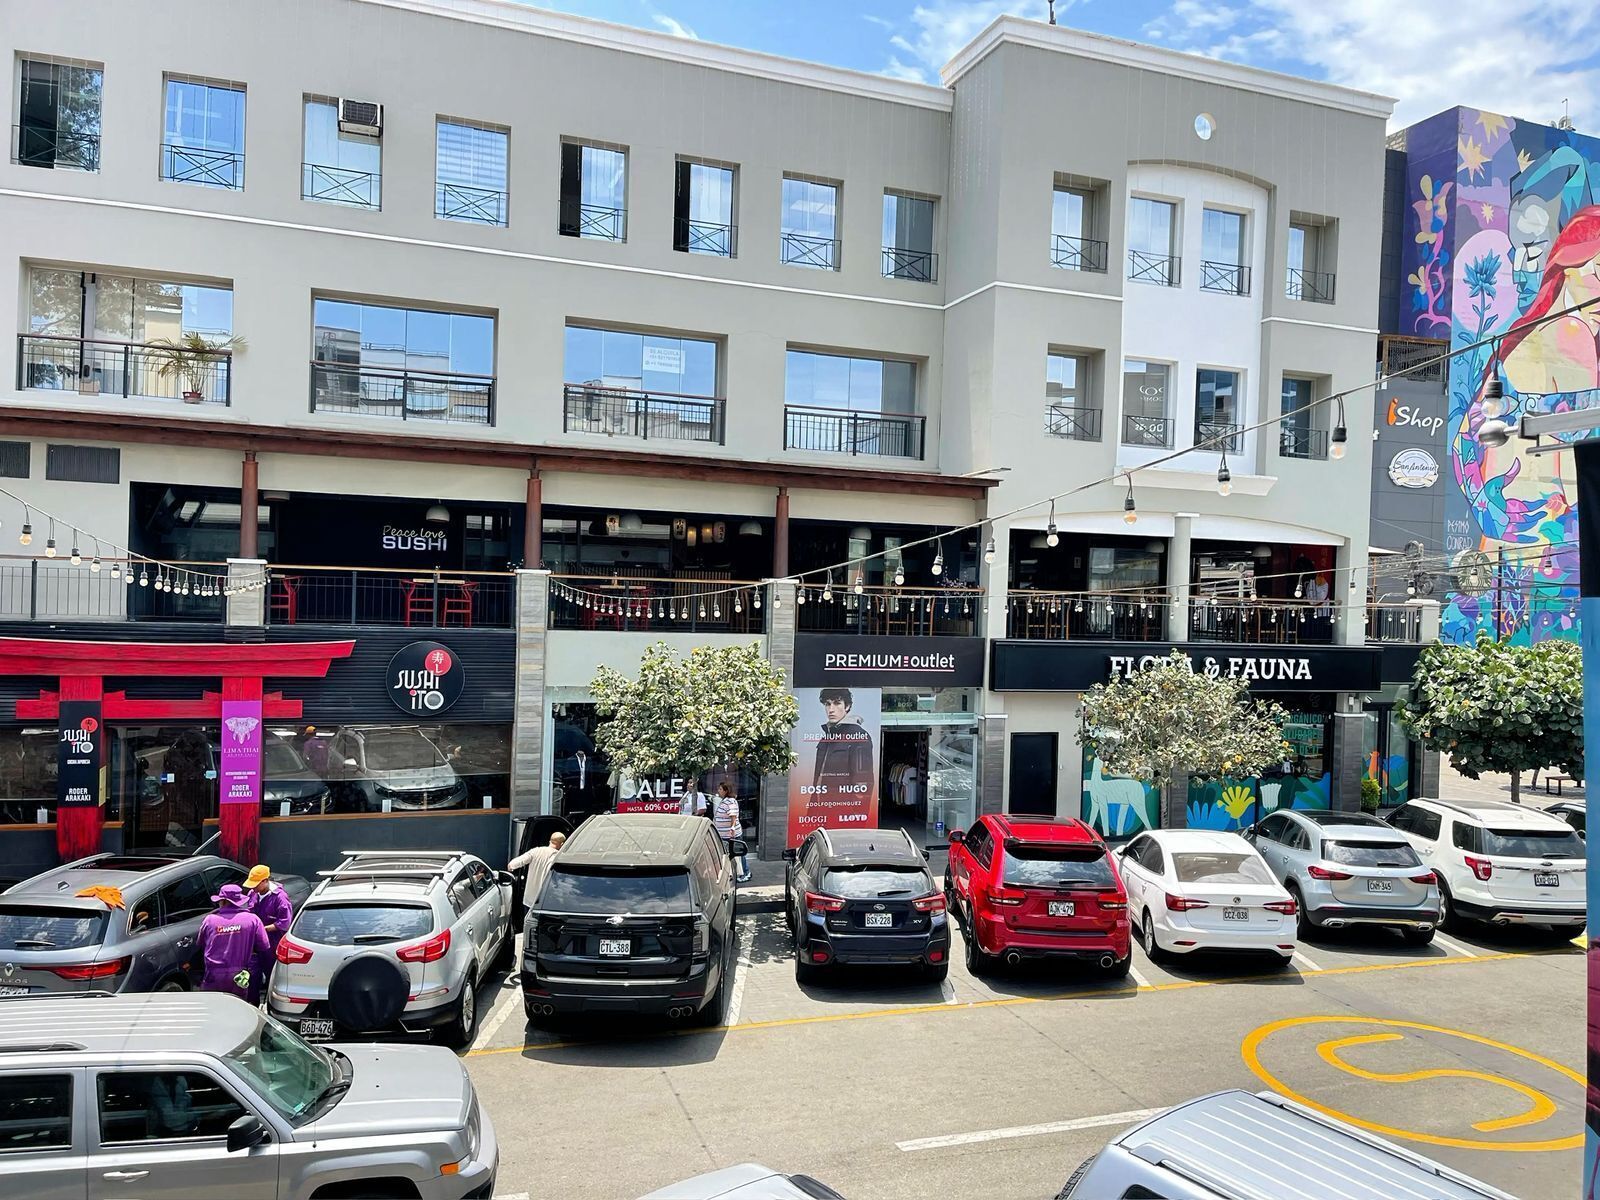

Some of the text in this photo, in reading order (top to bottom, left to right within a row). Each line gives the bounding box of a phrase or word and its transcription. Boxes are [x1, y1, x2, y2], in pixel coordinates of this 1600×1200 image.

[1387, 398, 1444, 437] iShop
[383, 525, 446, 539] Peace love
[382, 535, 448, 552] SUSHI
[825, 652, 955, 669] PREMIUM outlet
[1228, 657, 1313, 680] FAUNA
[804, 731, 869, 741] PREMIUM outlet
[68, 787, 88, 795] ROGER
[800, 784, 868, 795] BOSS HUGO
[65, 794, 91, 802] ARAKAKI
[644, 803, 661, 811] 60%
[662, 802, 680, 811] OFF
[798, 814, 868, 823] BOGGI LLOYD
[600, 943, 630, 953] CTL-388
